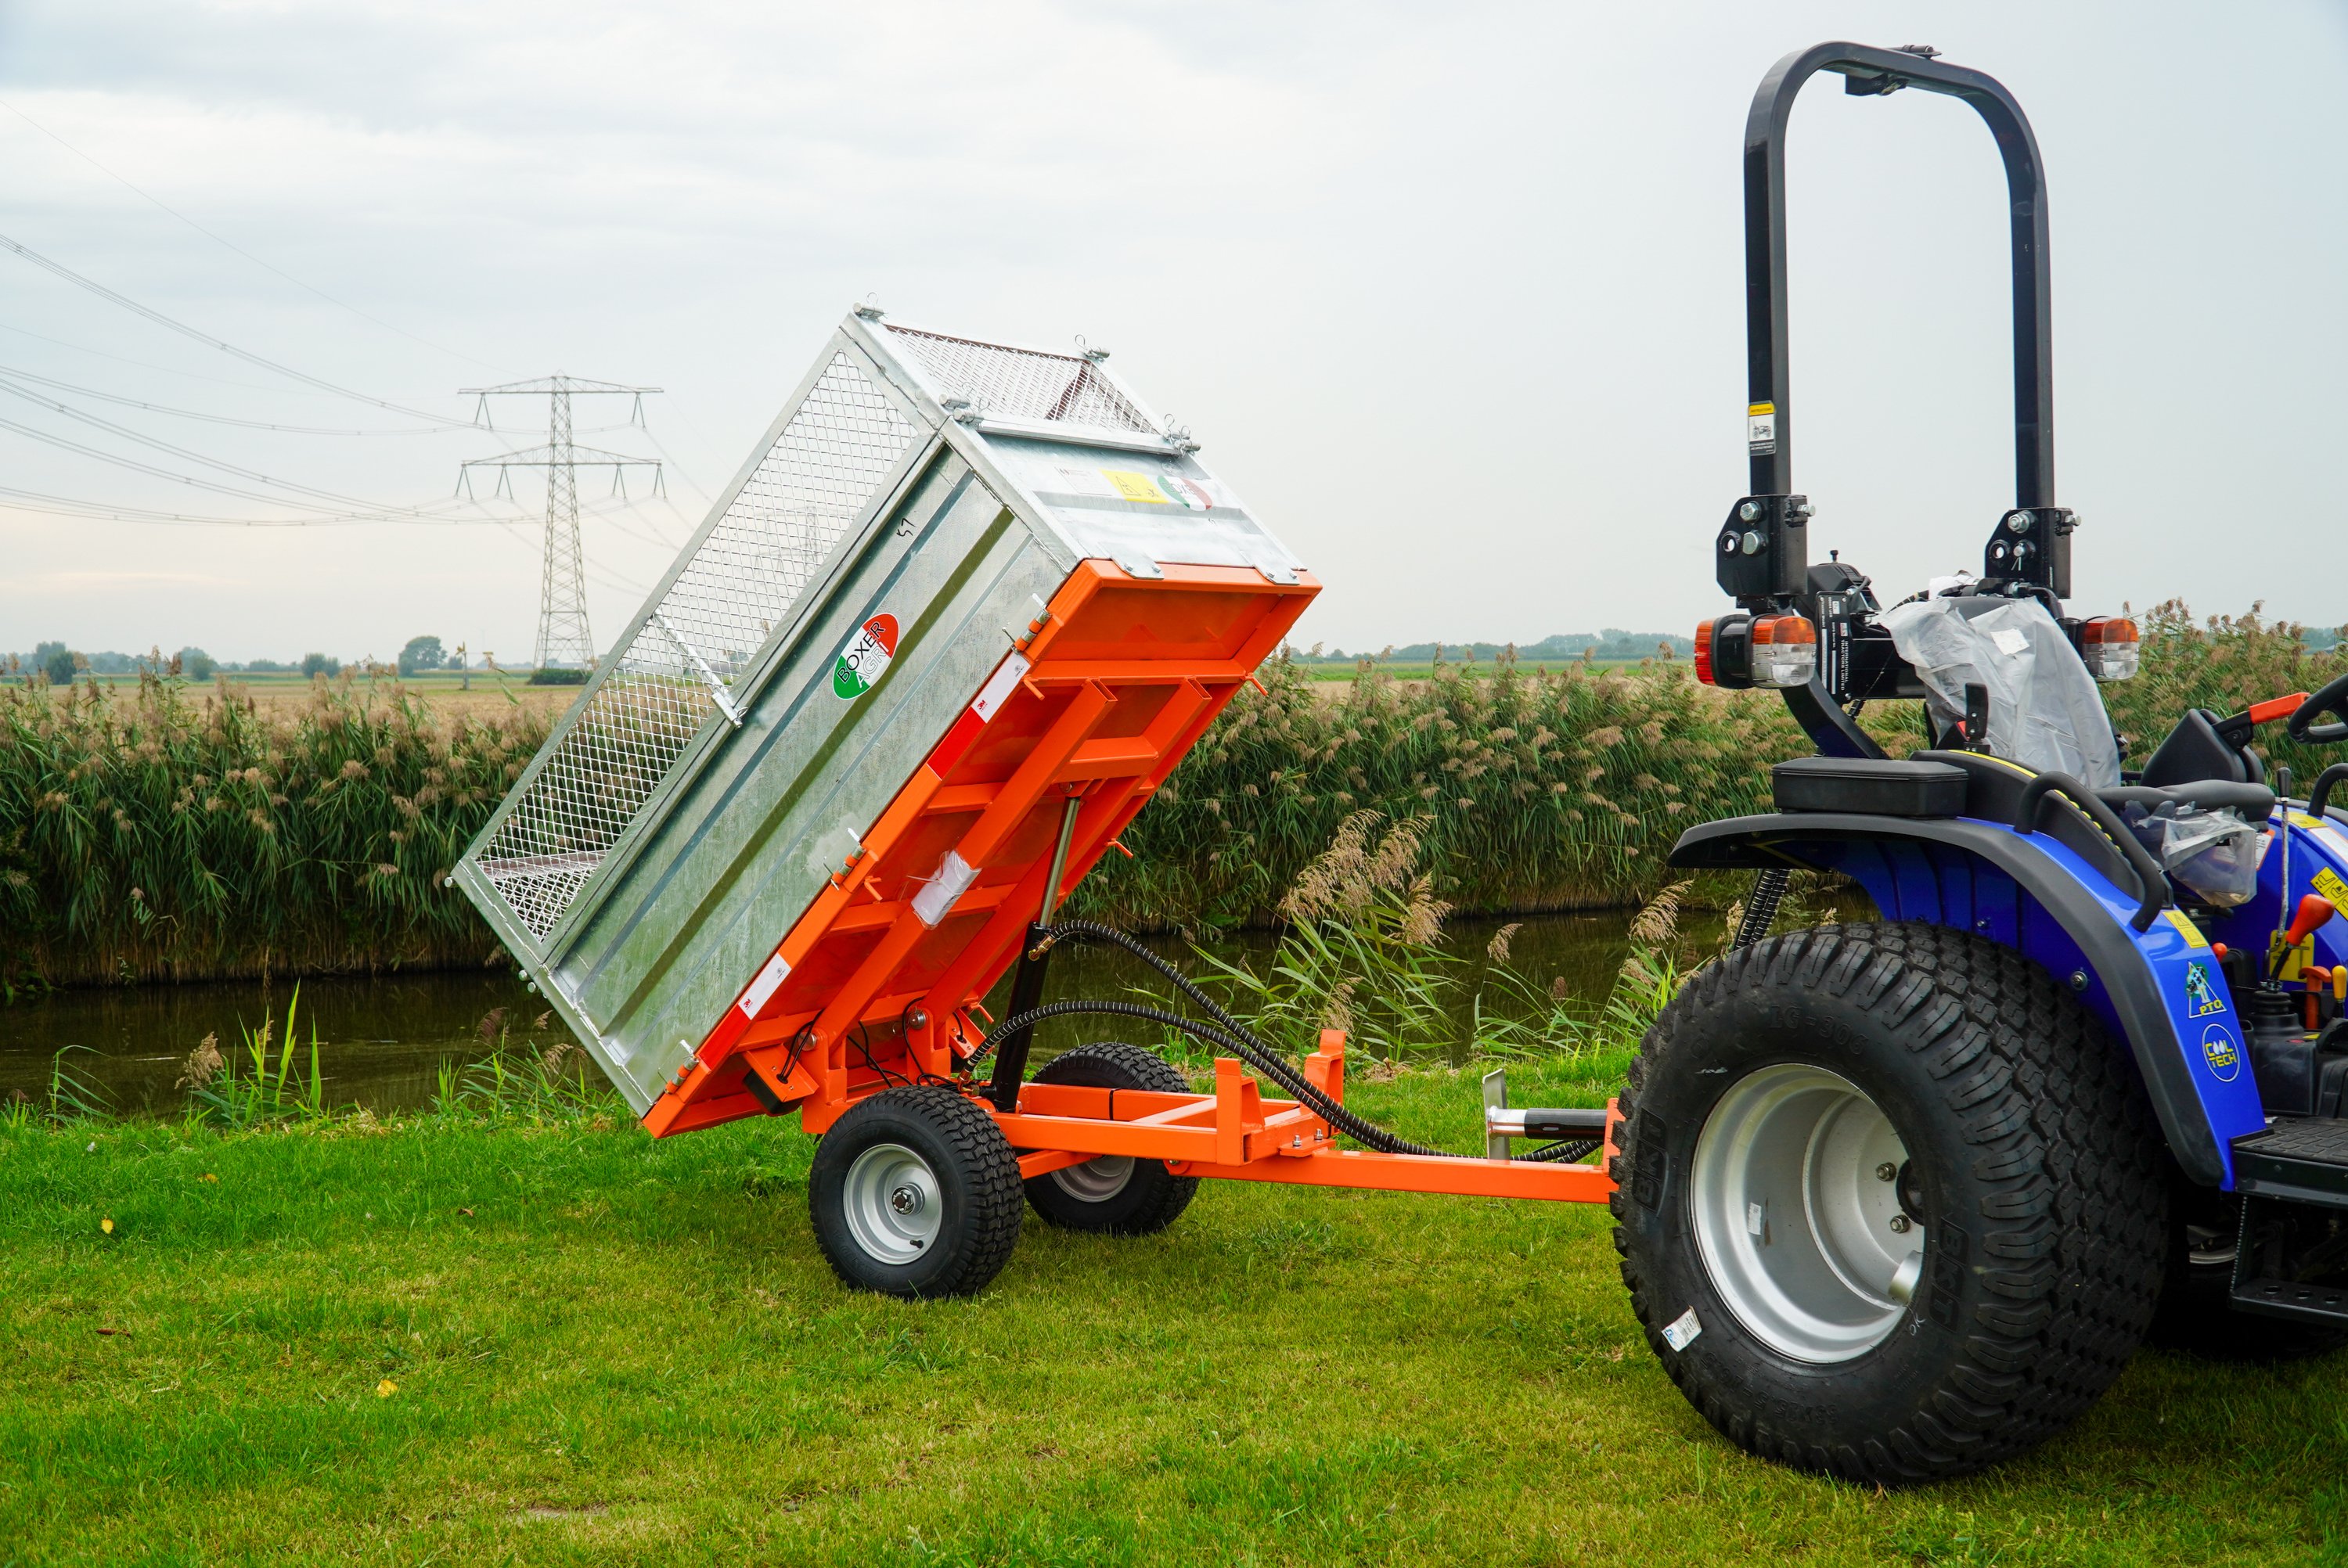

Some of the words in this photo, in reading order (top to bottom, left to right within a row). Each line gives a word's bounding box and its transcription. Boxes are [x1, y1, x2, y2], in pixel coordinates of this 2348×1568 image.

[837, 621, 886, 683] BOXER
[856, 641, 890, 689] AGRI
[978, 699, 986, 710] 3M
[2199, 999, 2222, 1015] PTO
[2209, 1052, 2237, 1068] TECH
